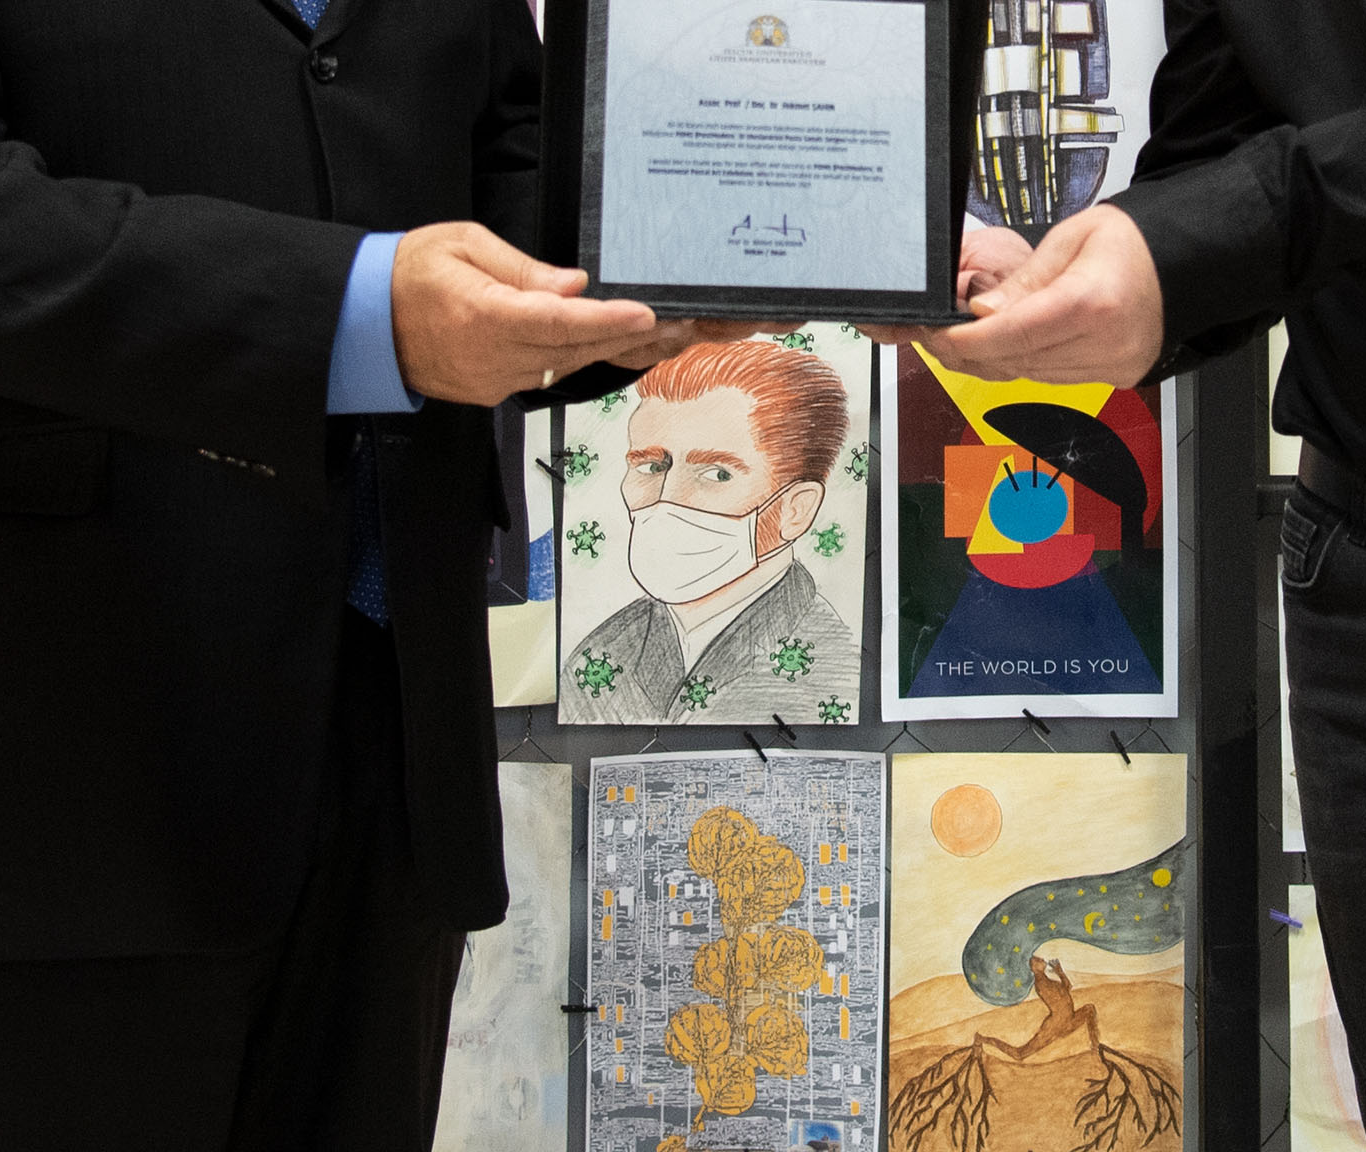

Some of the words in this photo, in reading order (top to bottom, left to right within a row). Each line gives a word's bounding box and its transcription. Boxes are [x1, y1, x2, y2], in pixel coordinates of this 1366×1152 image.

[935, 661, 975, 676] THE
[982, 659, 1057, 676] WORLD
[1064, 659, 1081, 673] IS
[1088, 658, 1129, 674] YOU
